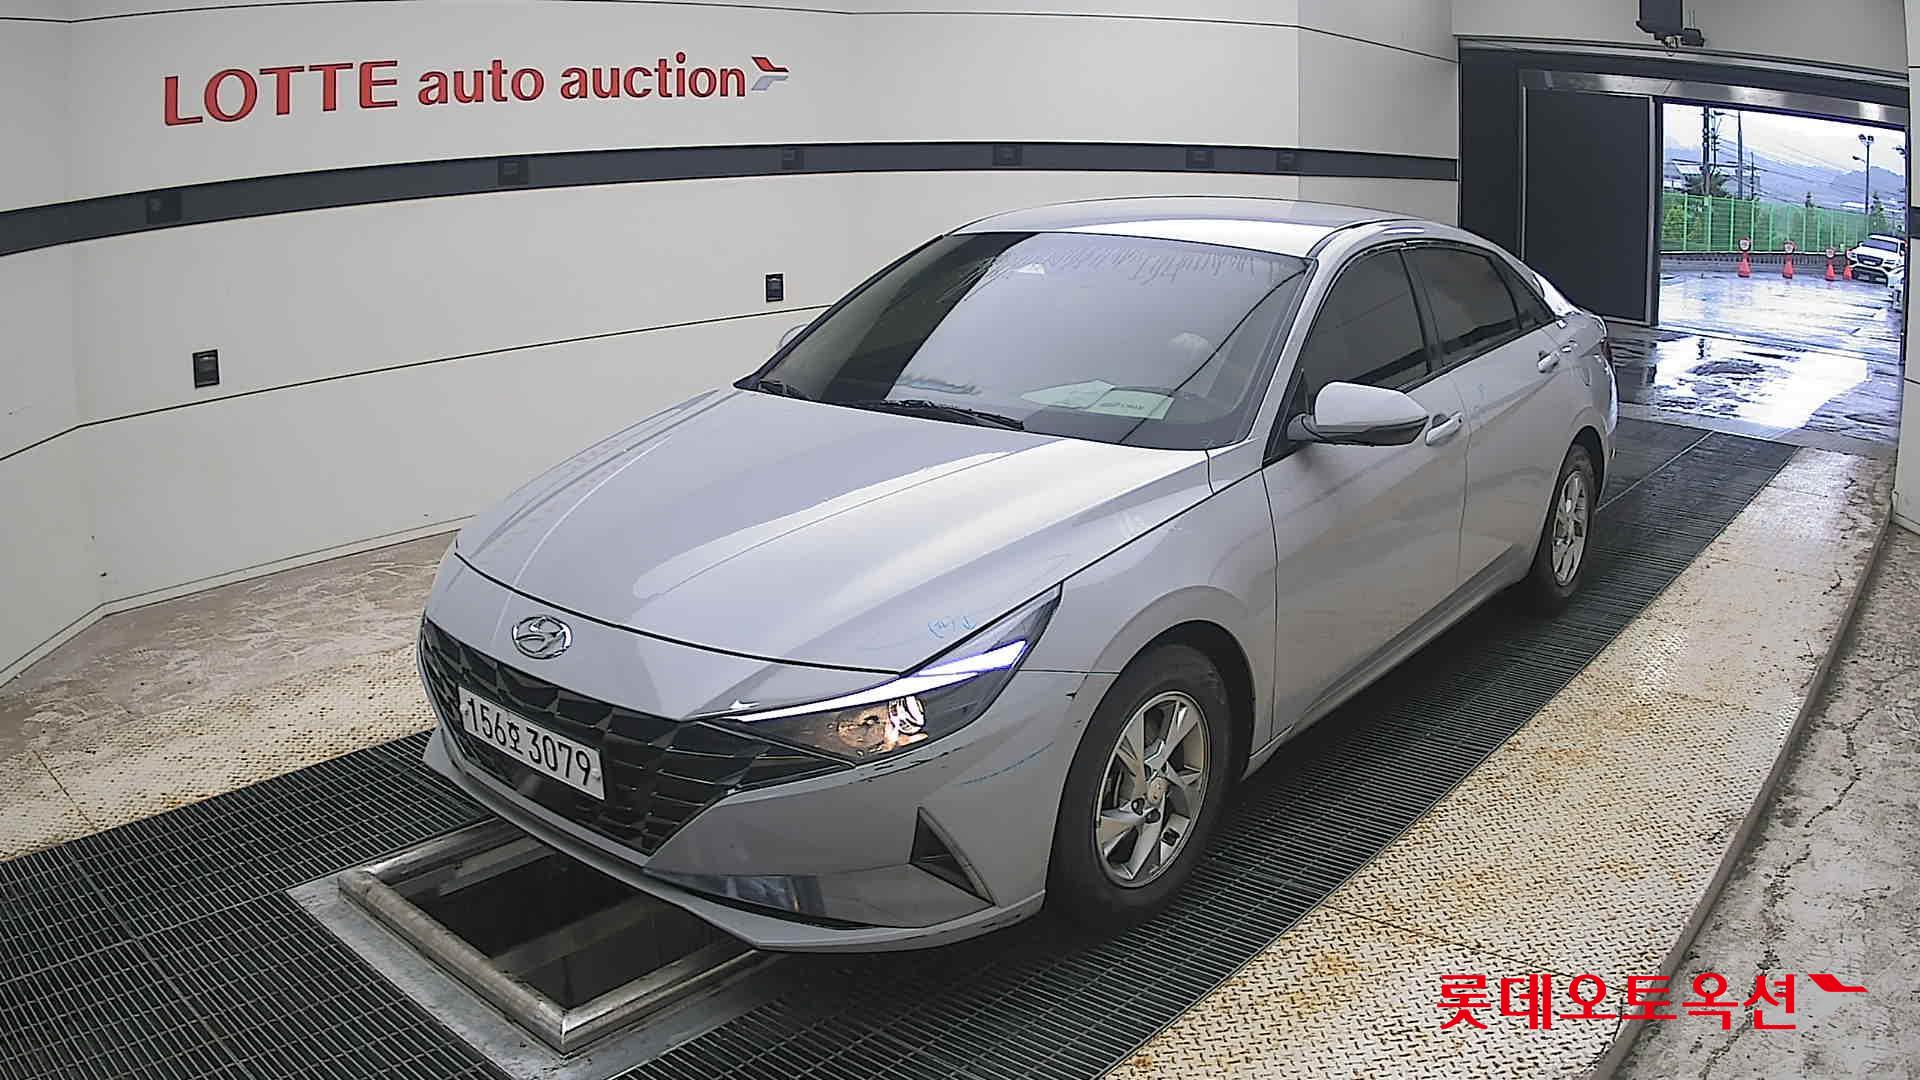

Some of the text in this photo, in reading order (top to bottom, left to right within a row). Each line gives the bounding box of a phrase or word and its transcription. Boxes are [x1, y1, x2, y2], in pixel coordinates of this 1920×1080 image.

[163, 52, 746, 127] LOTTE auto auction
